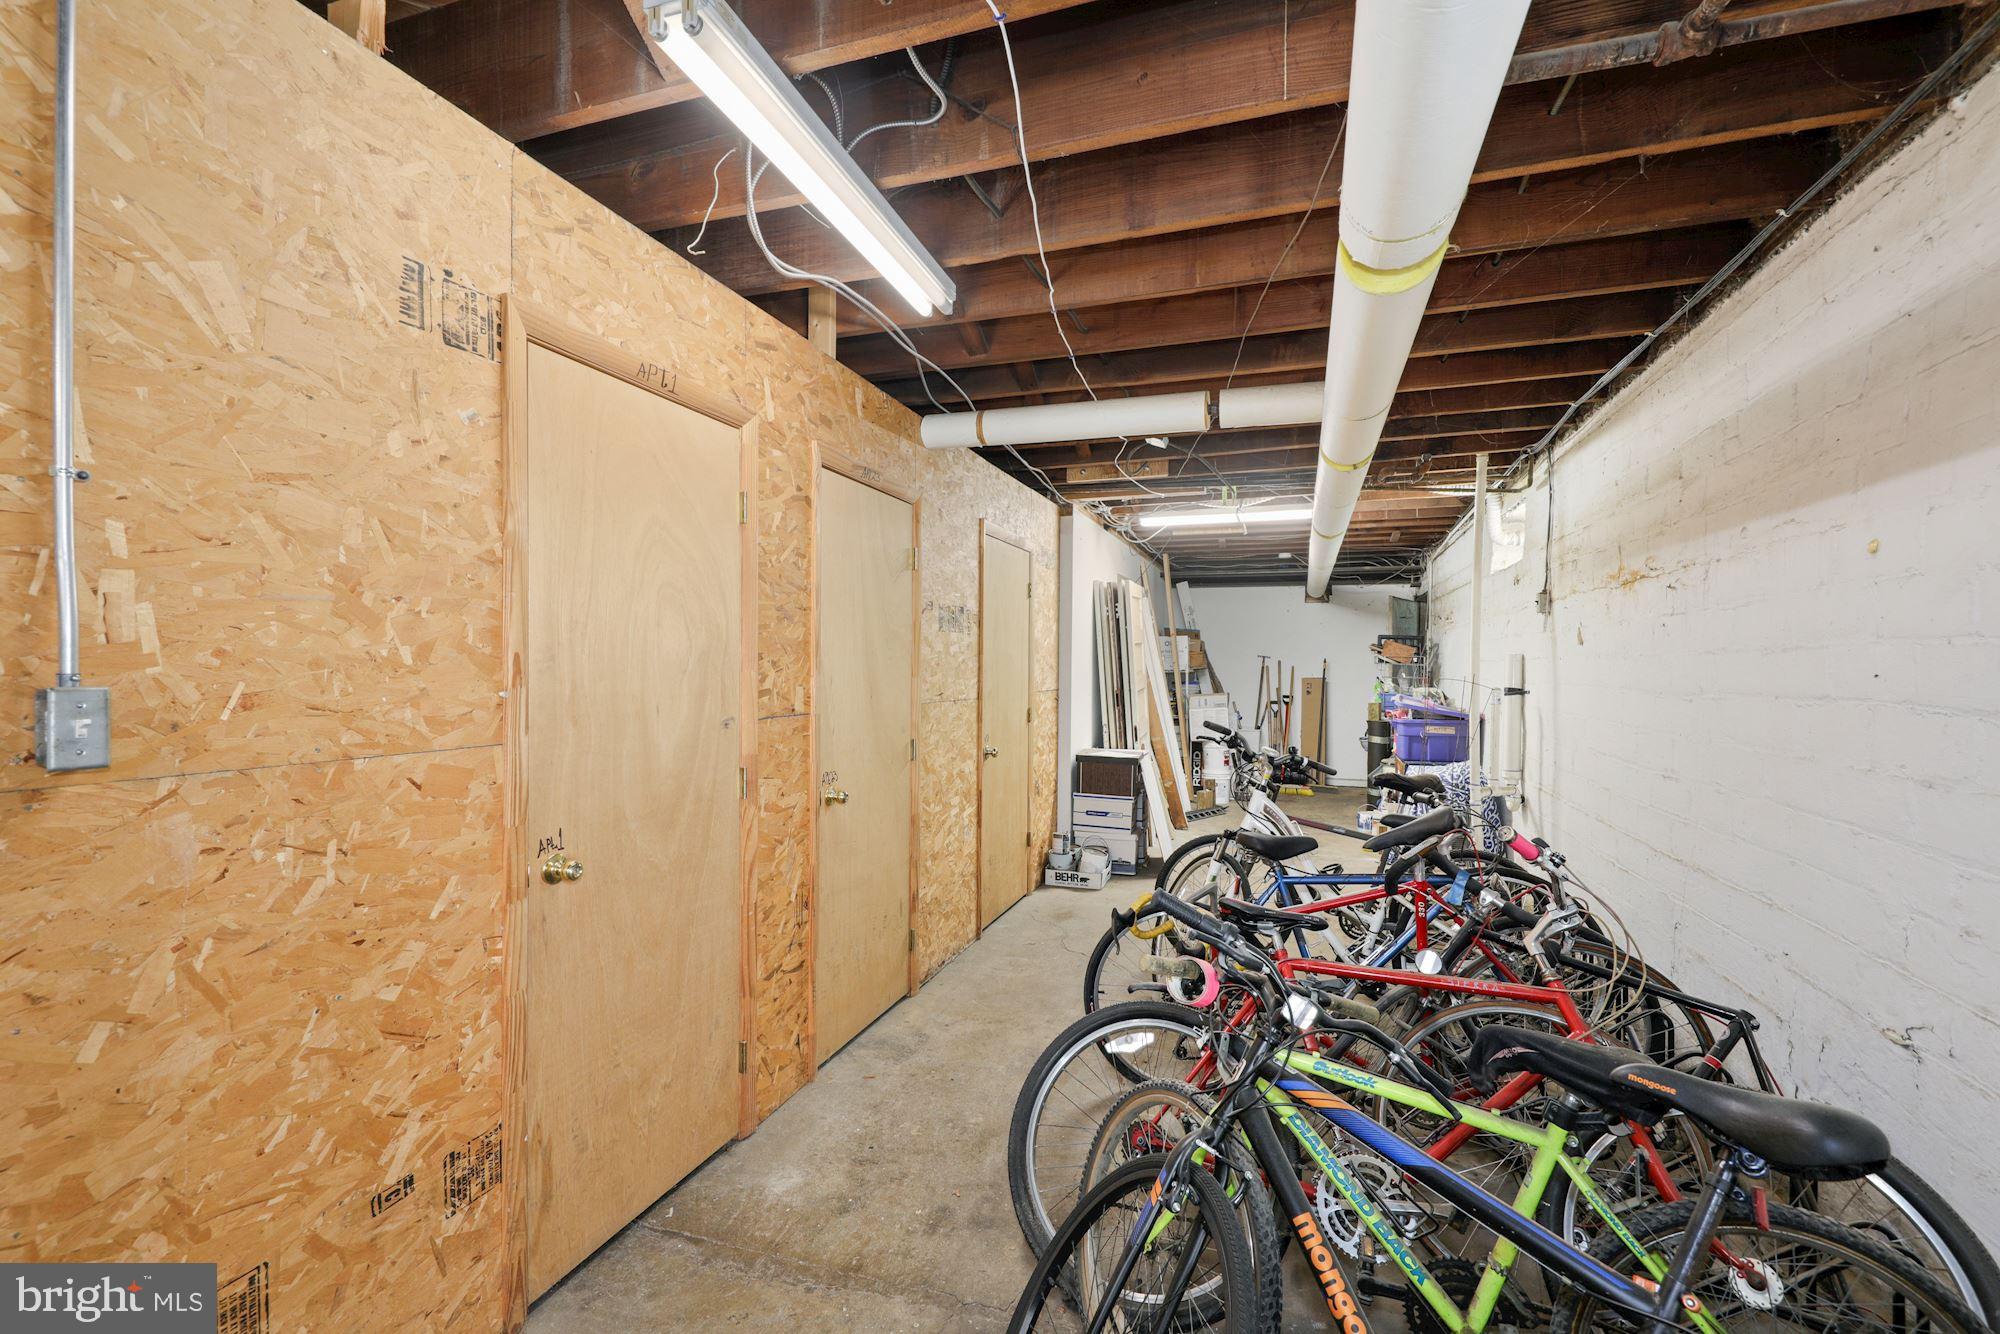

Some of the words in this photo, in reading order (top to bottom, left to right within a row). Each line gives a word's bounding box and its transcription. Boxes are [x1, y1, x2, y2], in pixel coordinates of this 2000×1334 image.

[1193, 751, 1201, 786] RIDGID
[1055, 872, 1080, 882] BEHR
[1418, 901, 1426, 918] 330
[1627, 1072, 1677, 1096] mongoose
[1288, 1111, 1376, 1218] DIAMOND
[1372, 1219, 1431, 1287] BACK
